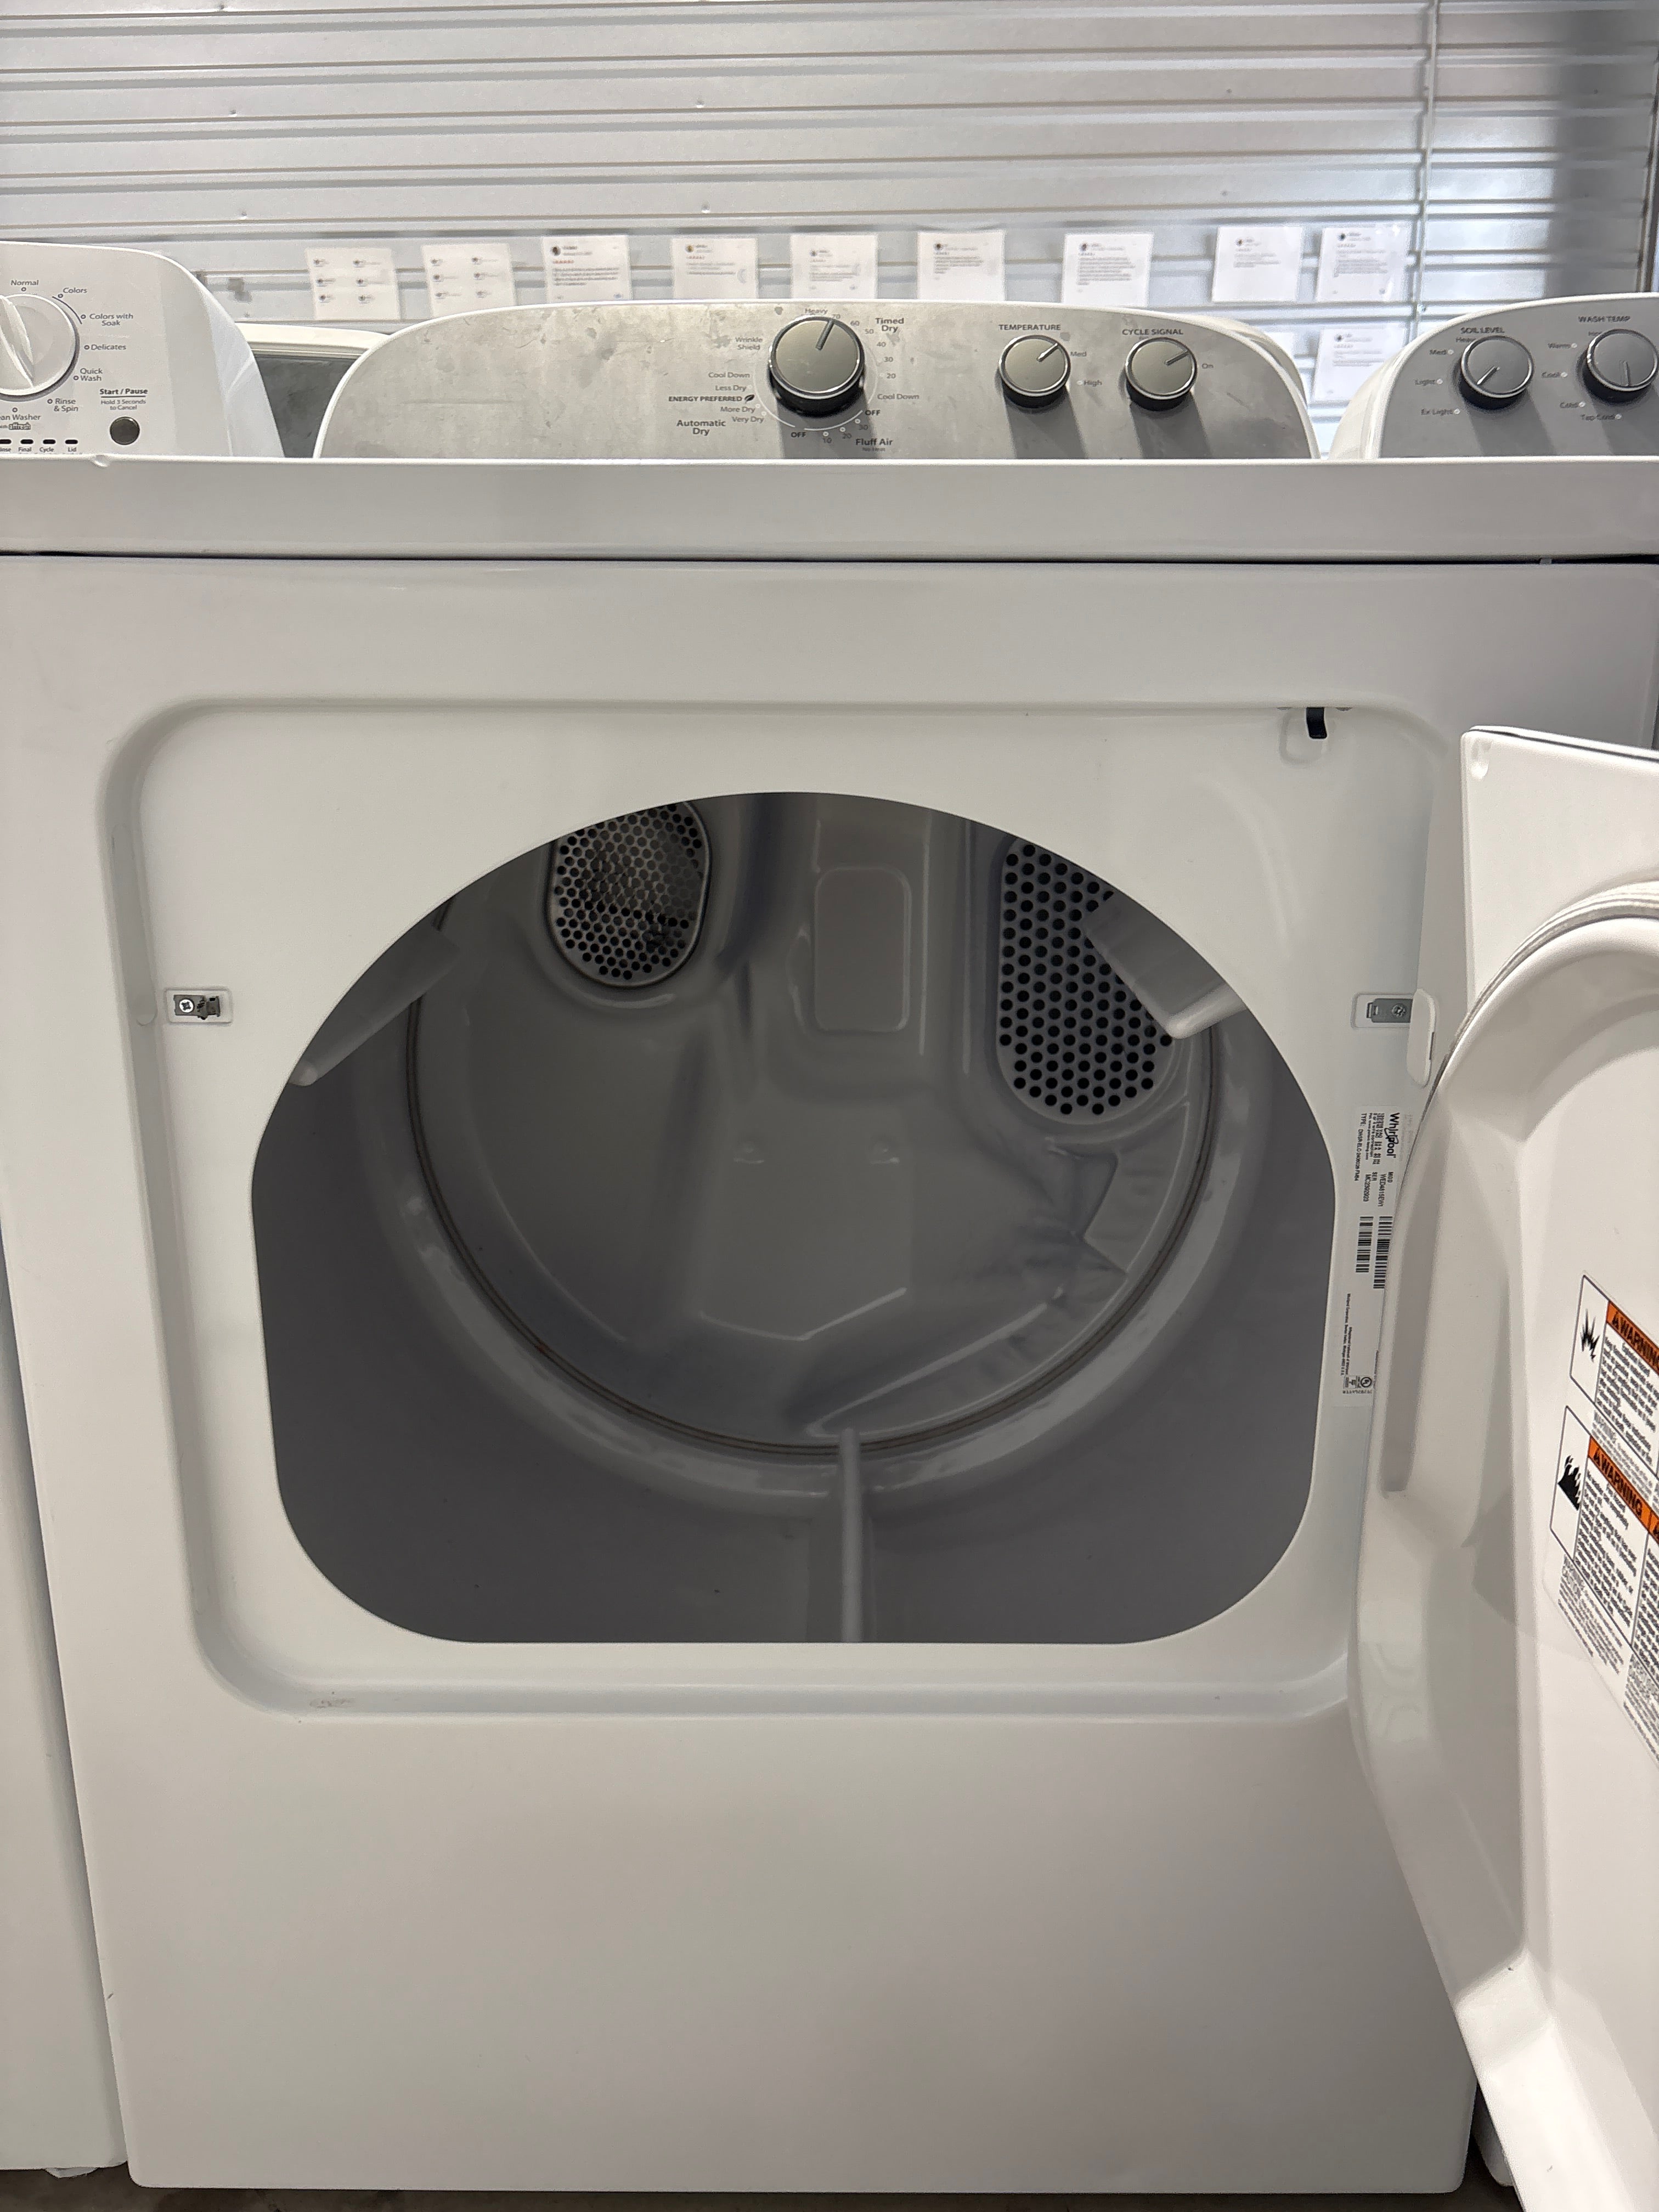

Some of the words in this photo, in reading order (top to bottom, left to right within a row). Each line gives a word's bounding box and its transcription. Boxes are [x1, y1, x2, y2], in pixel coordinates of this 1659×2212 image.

[692, 428, 710, 436] Dry
[1384, 1113, 1400, 1156] Whirlpool
[1620, 1316, 1659, 1369] WARNIN
[1601, 1454, 1643, 1519] WARNING
